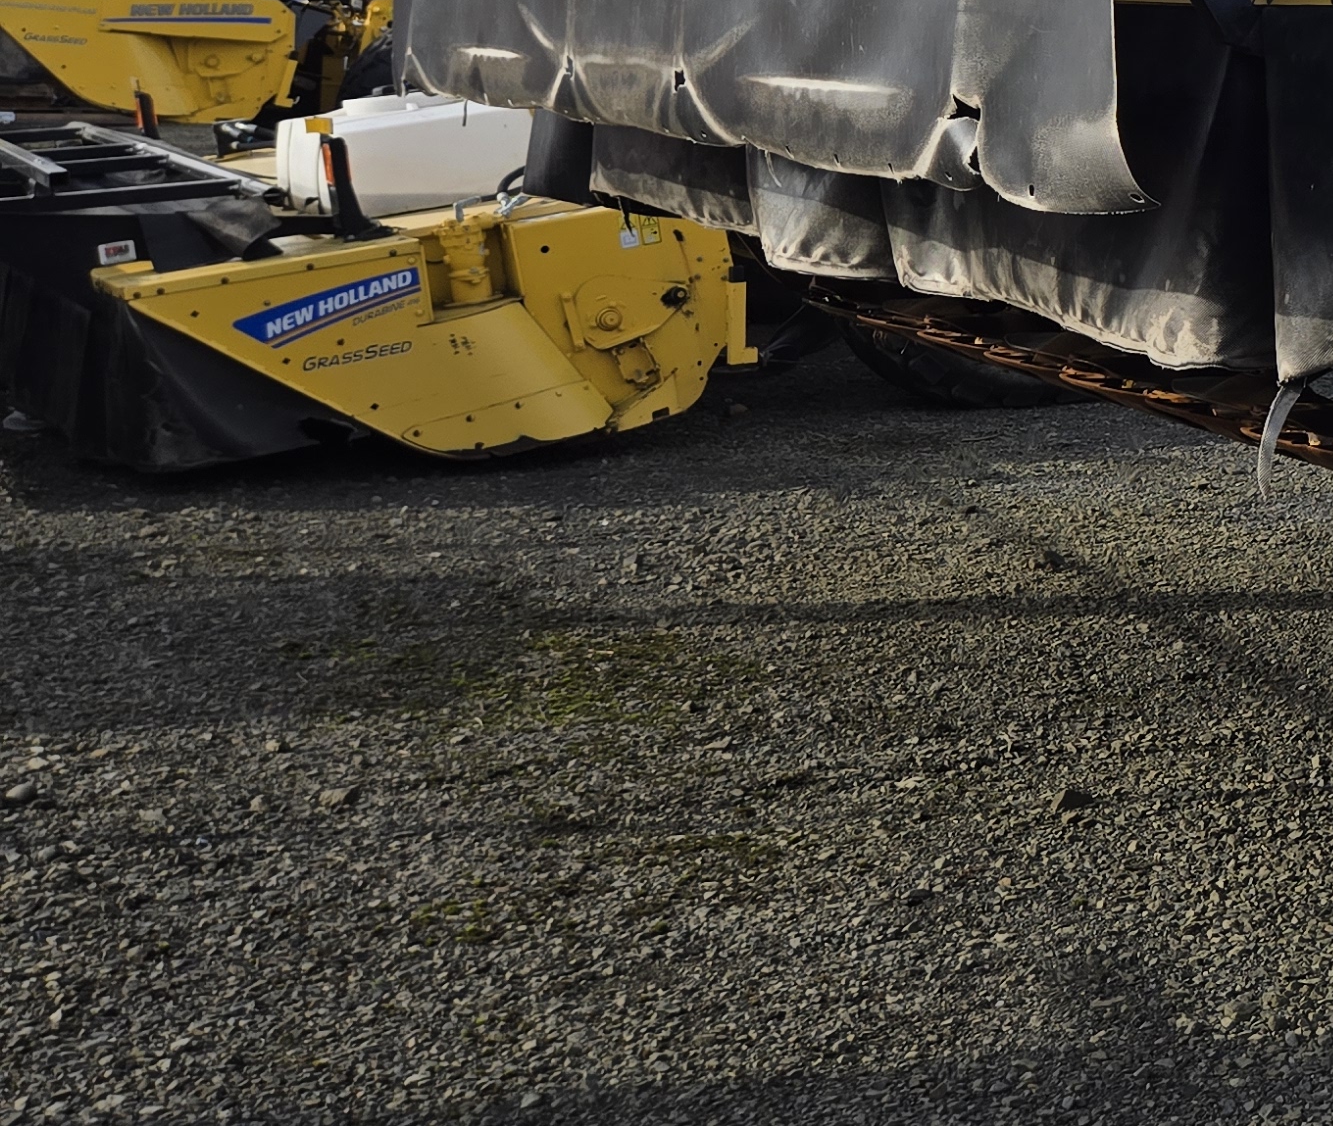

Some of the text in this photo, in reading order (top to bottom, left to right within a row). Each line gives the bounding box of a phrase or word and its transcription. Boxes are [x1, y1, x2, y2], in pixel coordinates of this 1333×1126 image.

[130, 3, 254, 16] NEW HOLLAND
[266, 271, 413, 339] NEW HOLLAND
[352, 301, 406, 327] DURABINE
